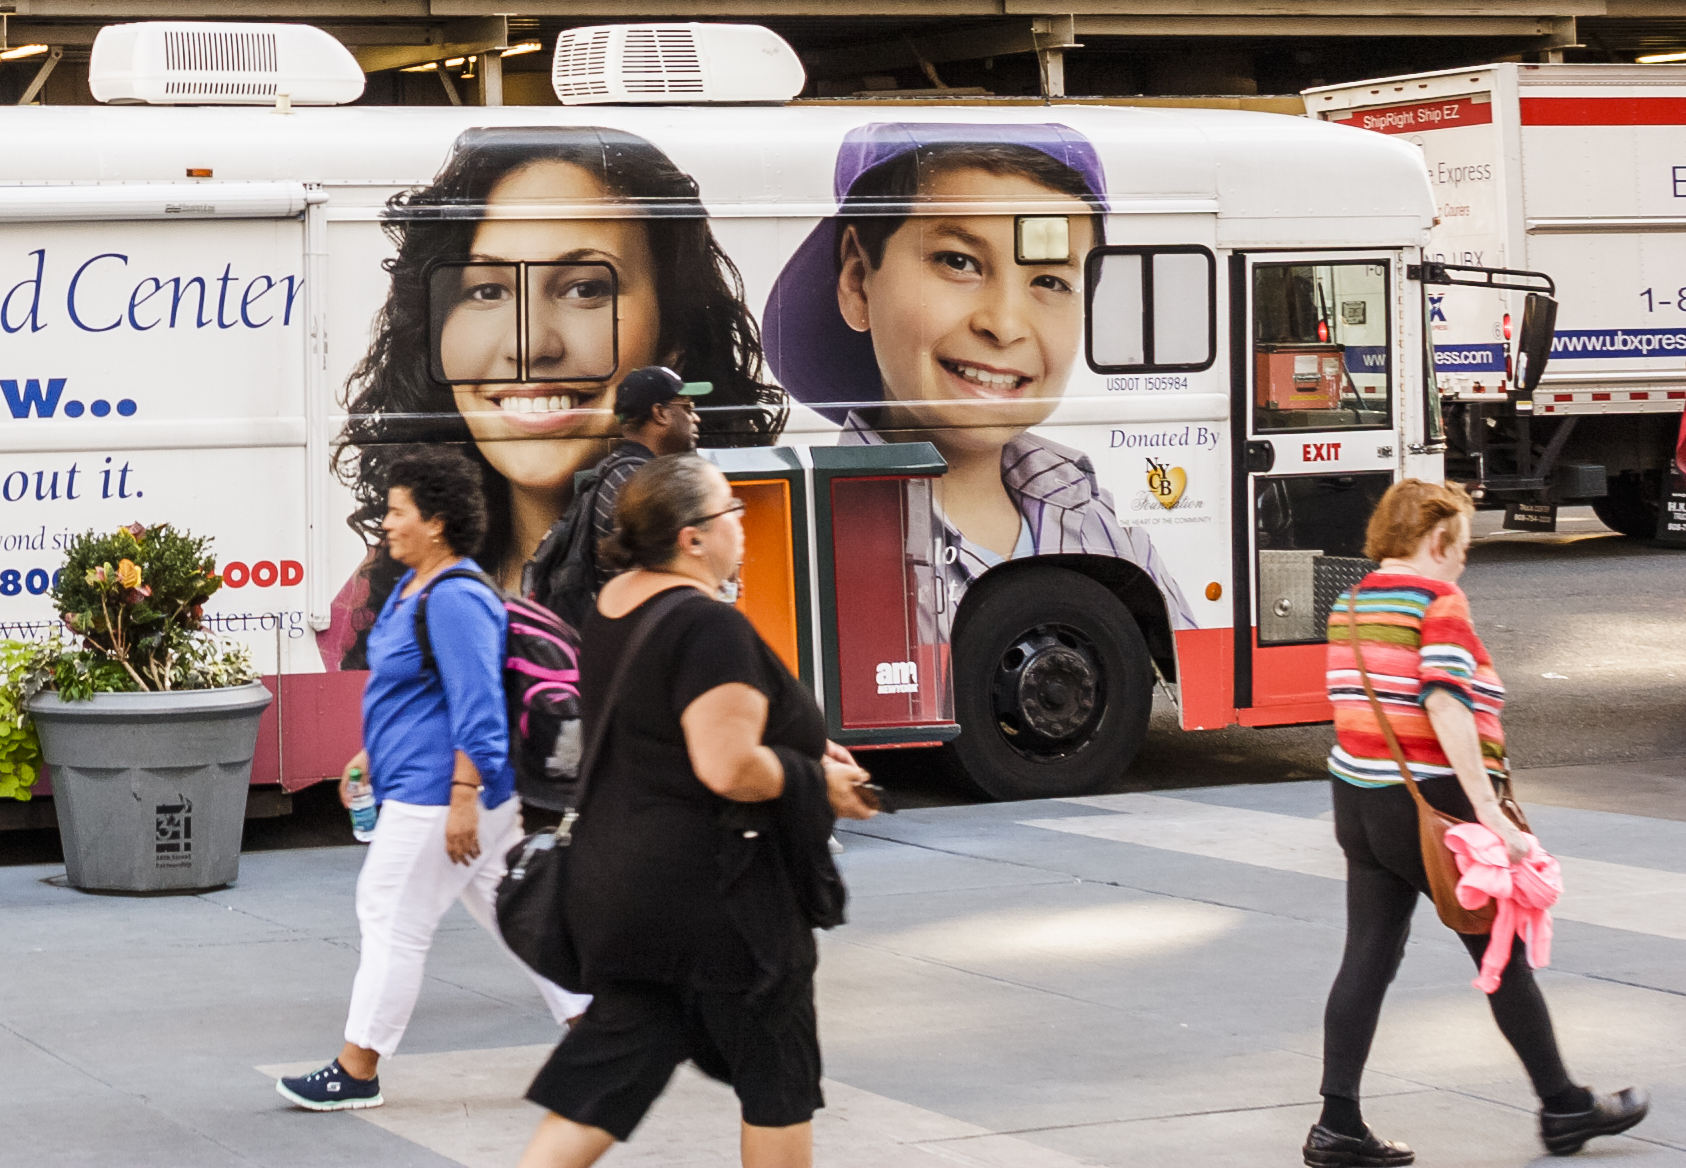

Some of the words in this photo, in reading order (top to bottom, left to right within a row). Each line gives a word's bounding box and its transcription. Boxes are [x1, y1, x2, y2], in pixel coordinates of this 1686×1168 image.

[1417, 107, 1442, 123] Ship
[1443, 104, 1460, 119] EZ
[1438, 162, 1492, 188] Express
[66, 252, 304, 333] Center
[1435, 350, 1494, 365] ess.com
[1106, 377, 1140, 391] USDOT
[1144, 376, 1189, 390] 1505984
[1109, 426, 1190, 449] Donated
[1196, 427, 1221, 451] By
[1302, 442, 1342, 462] EXIT
[100, 456, 145, 500] it.
